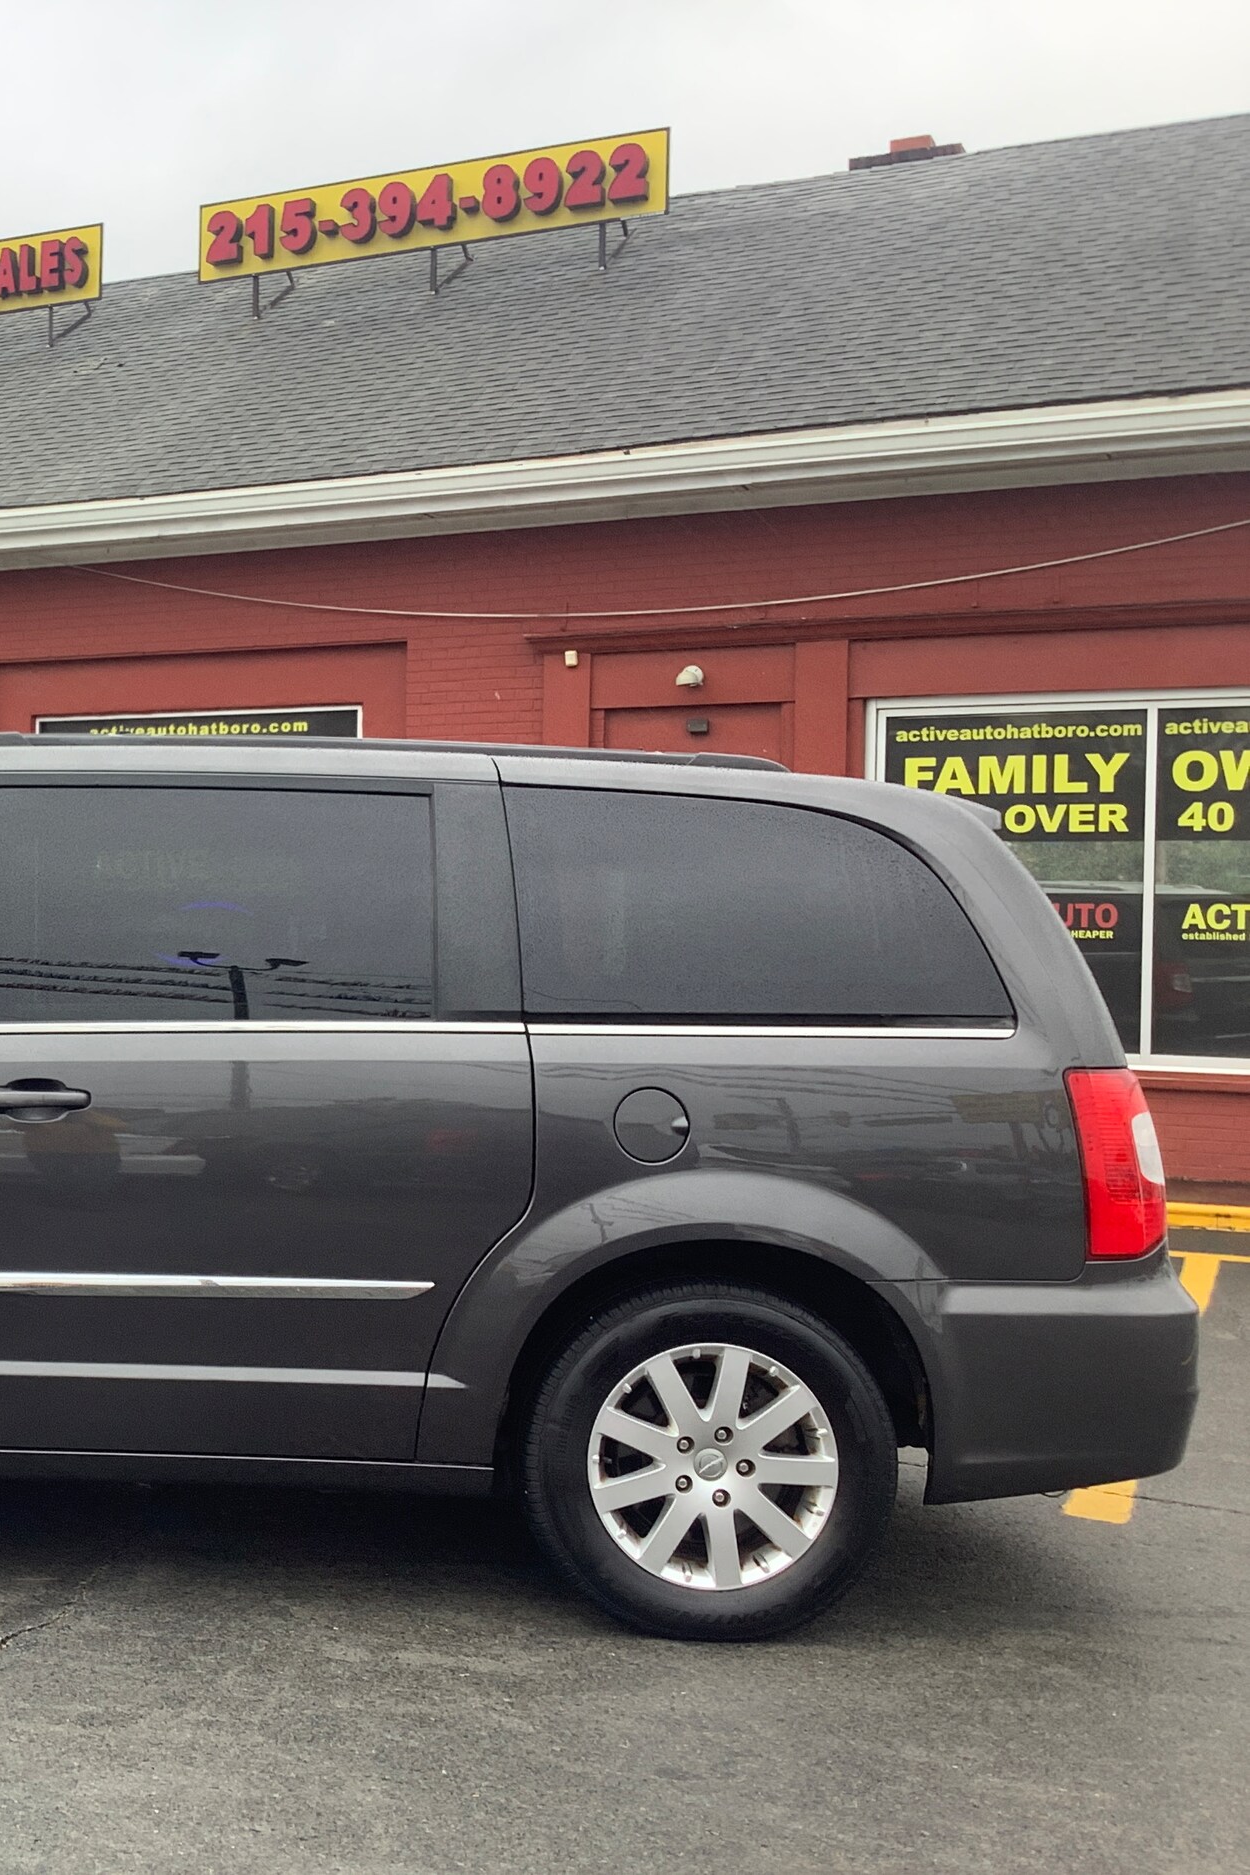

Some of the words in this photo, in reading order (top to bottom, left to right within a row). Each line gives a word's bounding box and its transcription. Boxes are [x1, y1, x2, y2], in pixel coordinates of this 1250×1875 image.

[206, 142, 649, 266] 215-394-8922
[896, 723, 1142, 742] activeautohatboro.com
[904, 753, 1130, 795] FAMILY
[1005, 803, 1129, 833] OVER
[1177, 801, 1235, 832] 40
[1181, 903, 1250, 930] ACT
[1181, 931, 1246, 941] established
